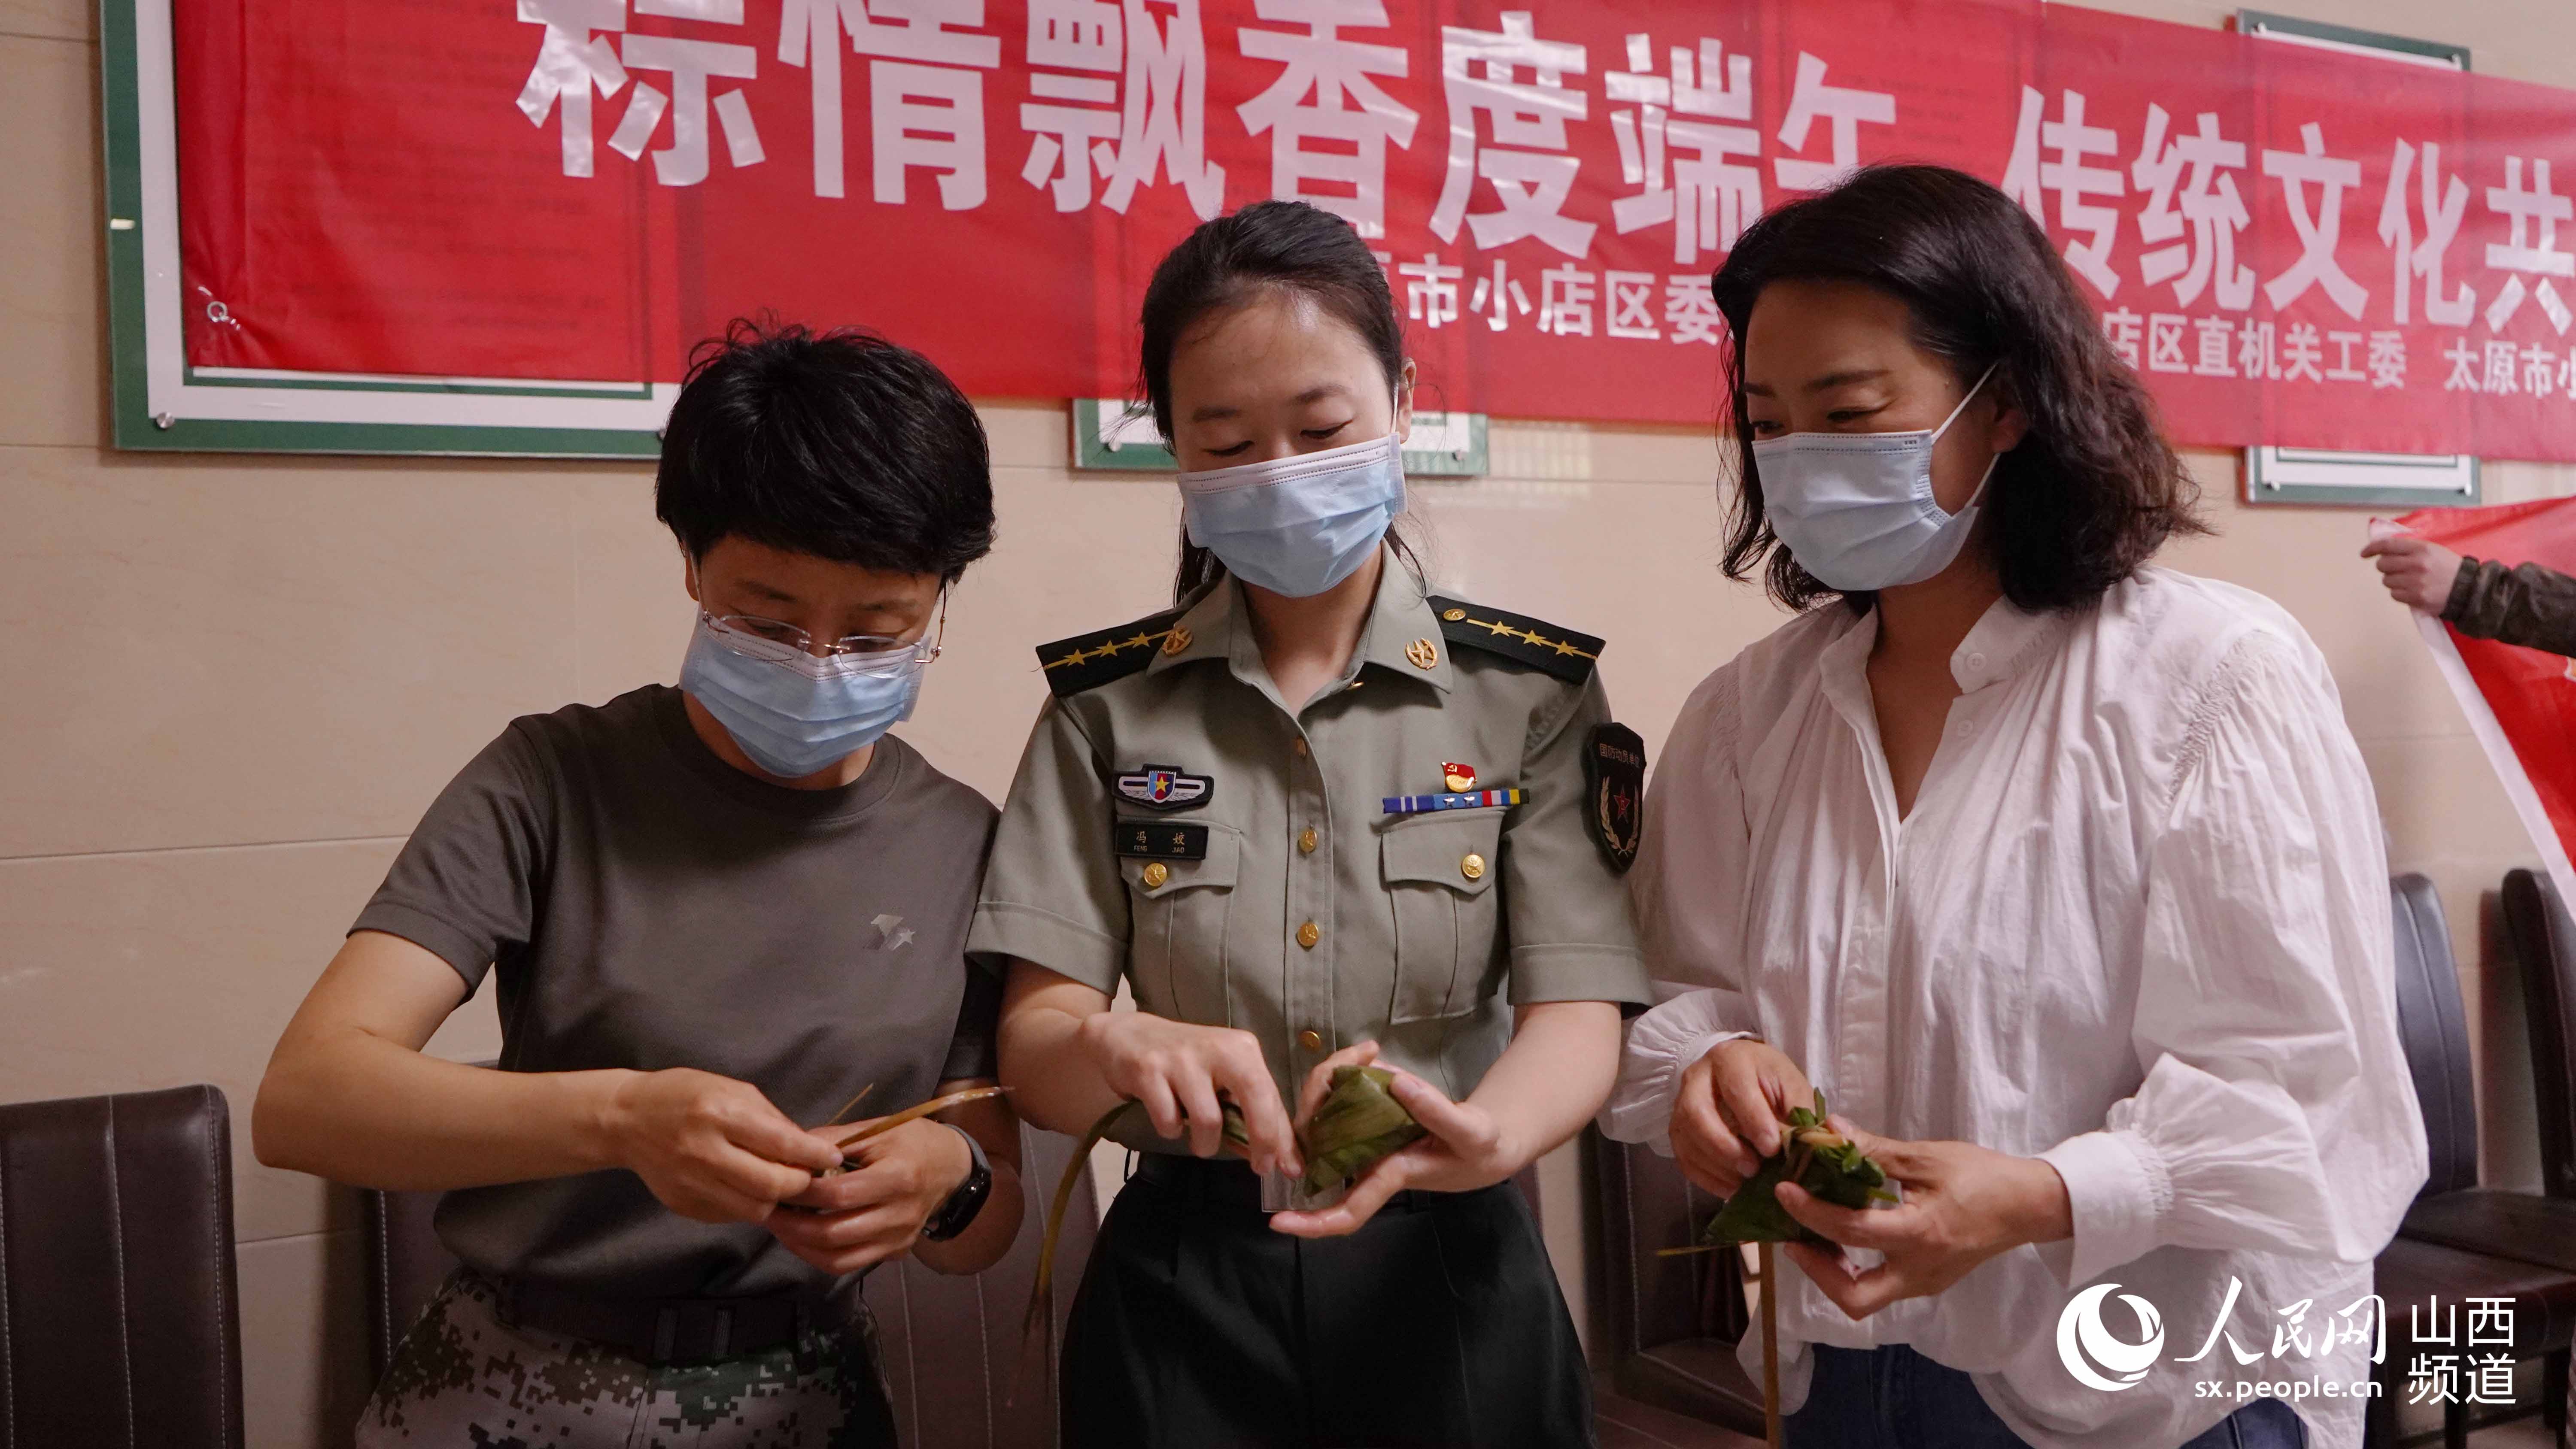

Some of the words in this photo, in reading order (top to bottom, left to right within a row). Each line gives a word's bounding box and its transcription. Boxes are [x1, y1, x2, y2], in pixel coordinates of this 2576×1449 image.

[2000, 84, 2576, 336] 传统文化共
[1372, 252, 1719, 345] 市小店区委
[1136, 831, 1147, 843] 冯
